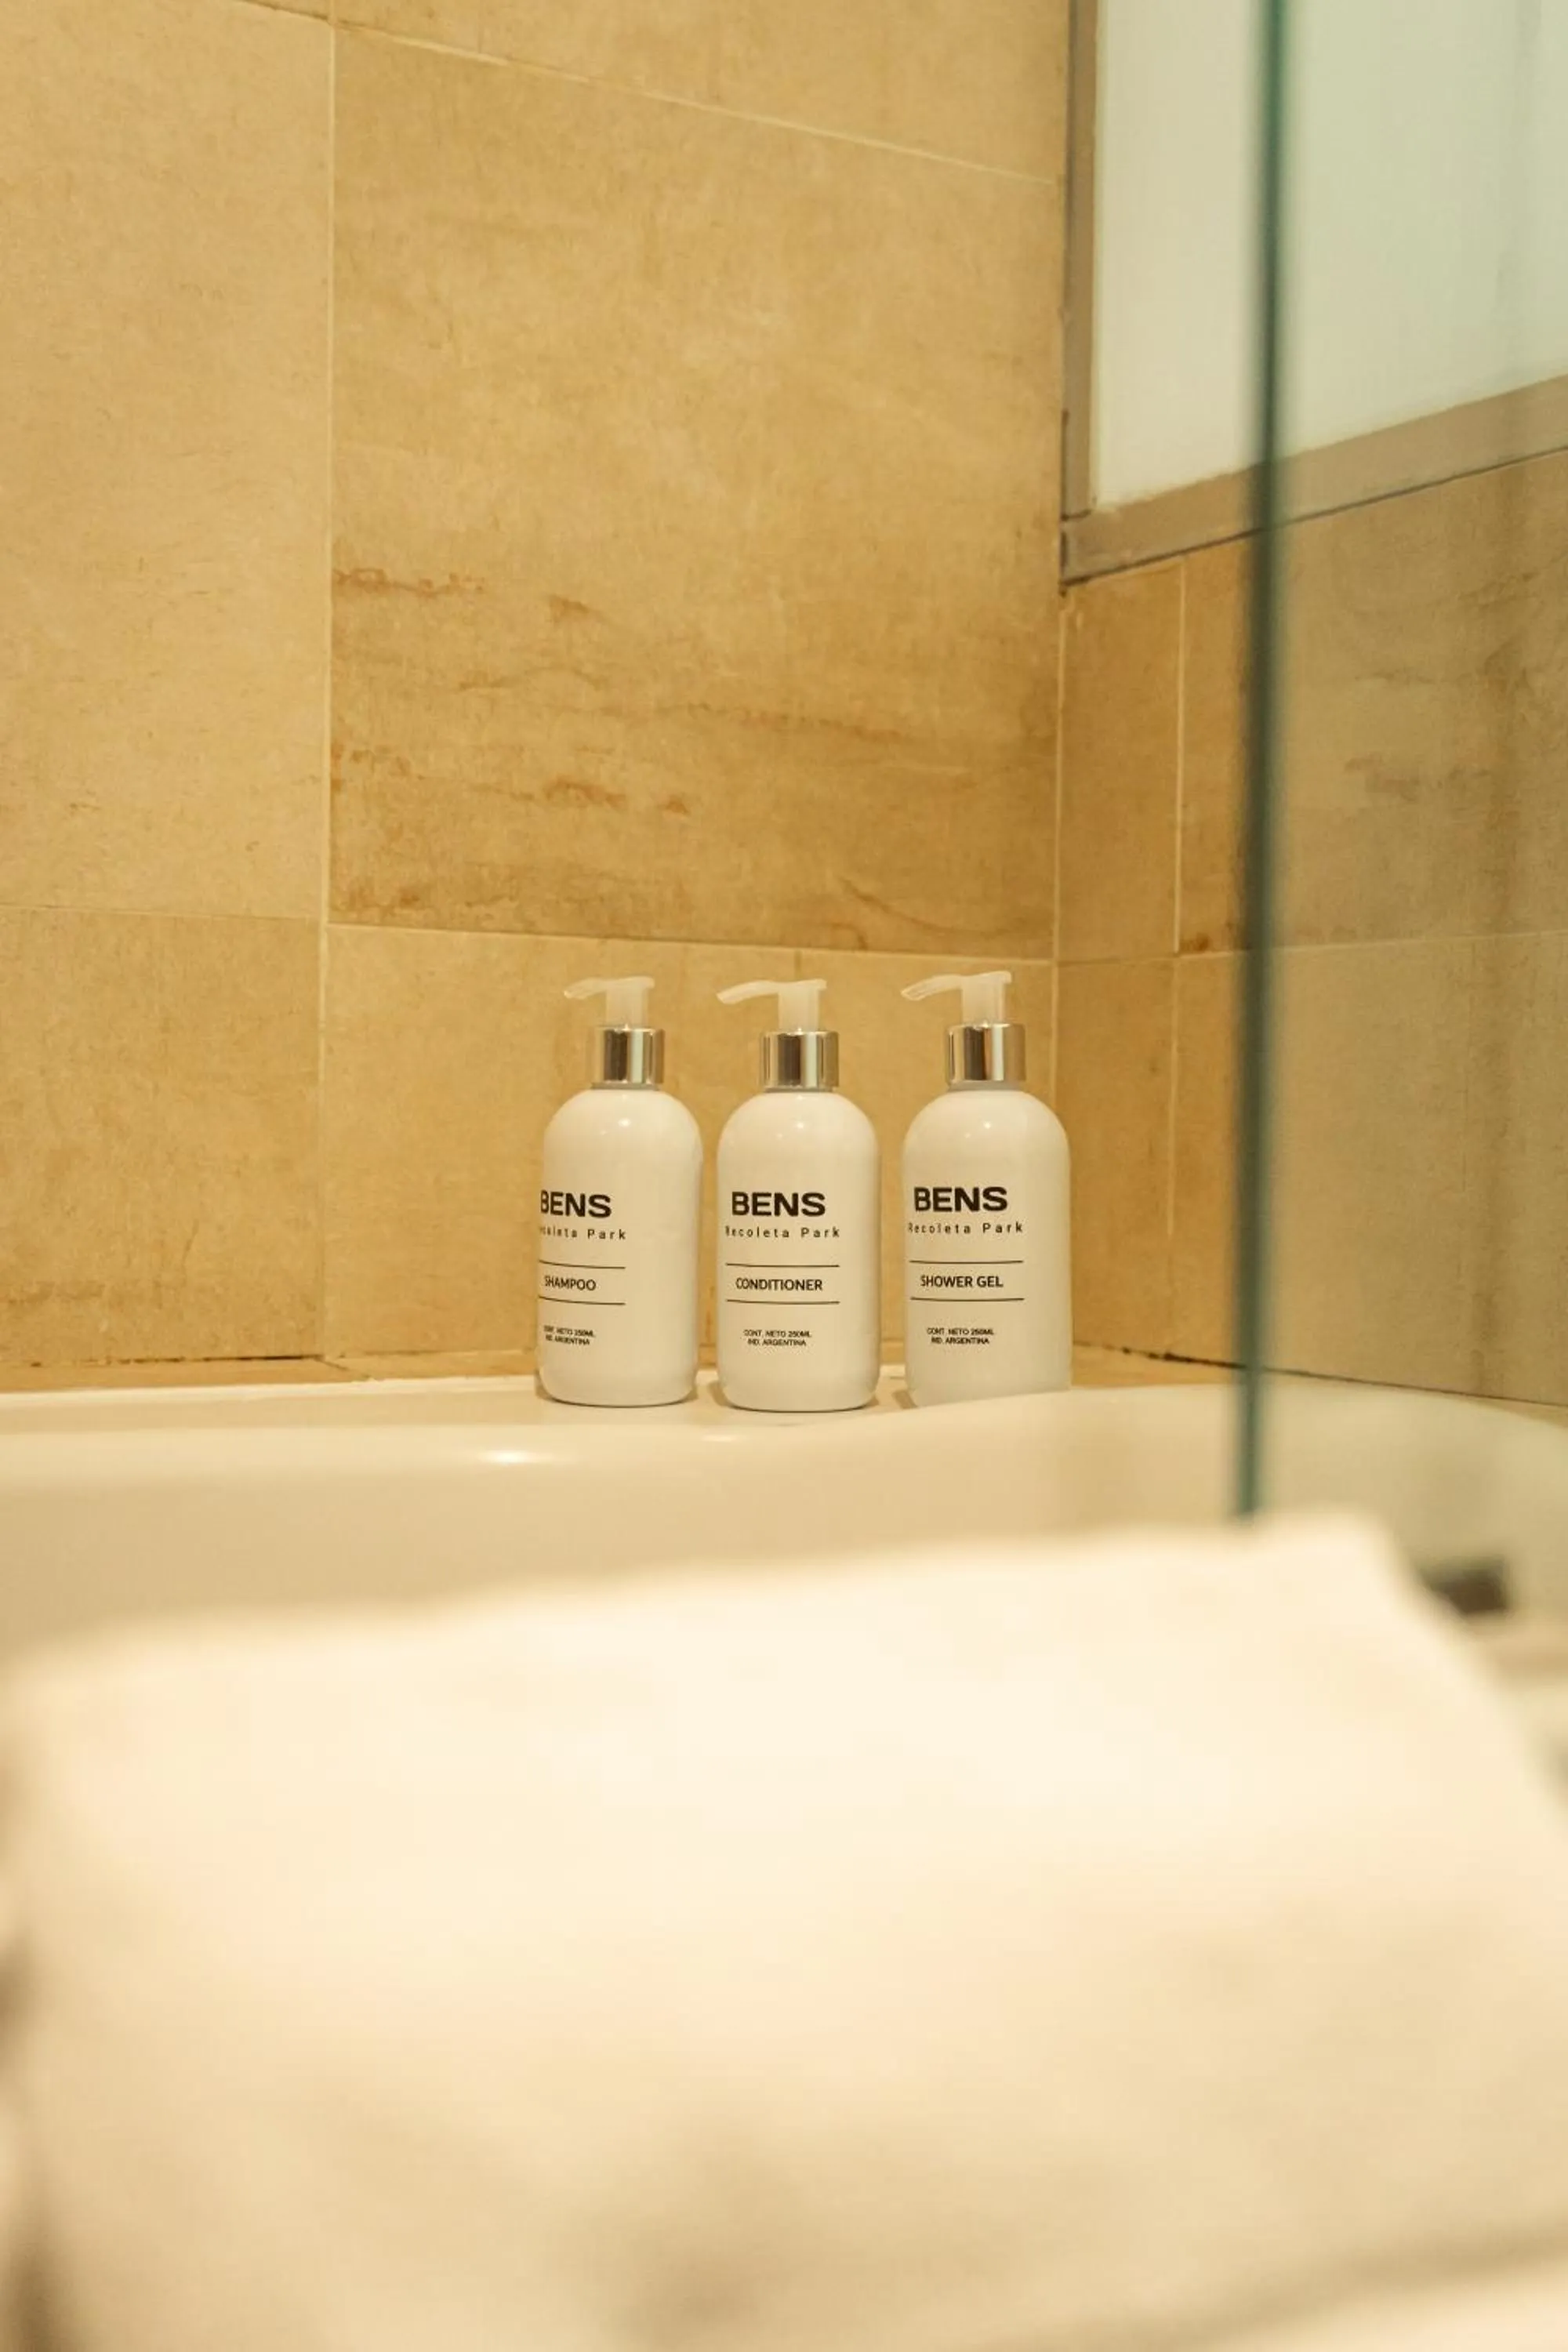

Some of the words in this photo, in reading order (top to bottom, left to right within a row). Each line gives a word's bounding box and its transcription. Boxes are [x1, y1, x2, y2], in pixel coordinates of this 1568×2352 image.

[540, 1189, 612, 1218] BENS
[731, 1191, 826, 1217] BENS
[914, 1186, 1008, 1212] BENS
[587, 1229, 626, 1240] Park
[725, 1225, 790, 1238] Recoleta
[800, 1226, 840, 1238] Park
[907, 1221, 971, 1234] Recoleta
[982, 1221, 1023, 1233] Park
[544, 1275, 597, 1291] SHAMPOO
[735, 1277, 823, 1291] CONDITIONER
[920, 1275, 973, 1288] SHOWER
[976, 1276, 1004, 1288] GEL
